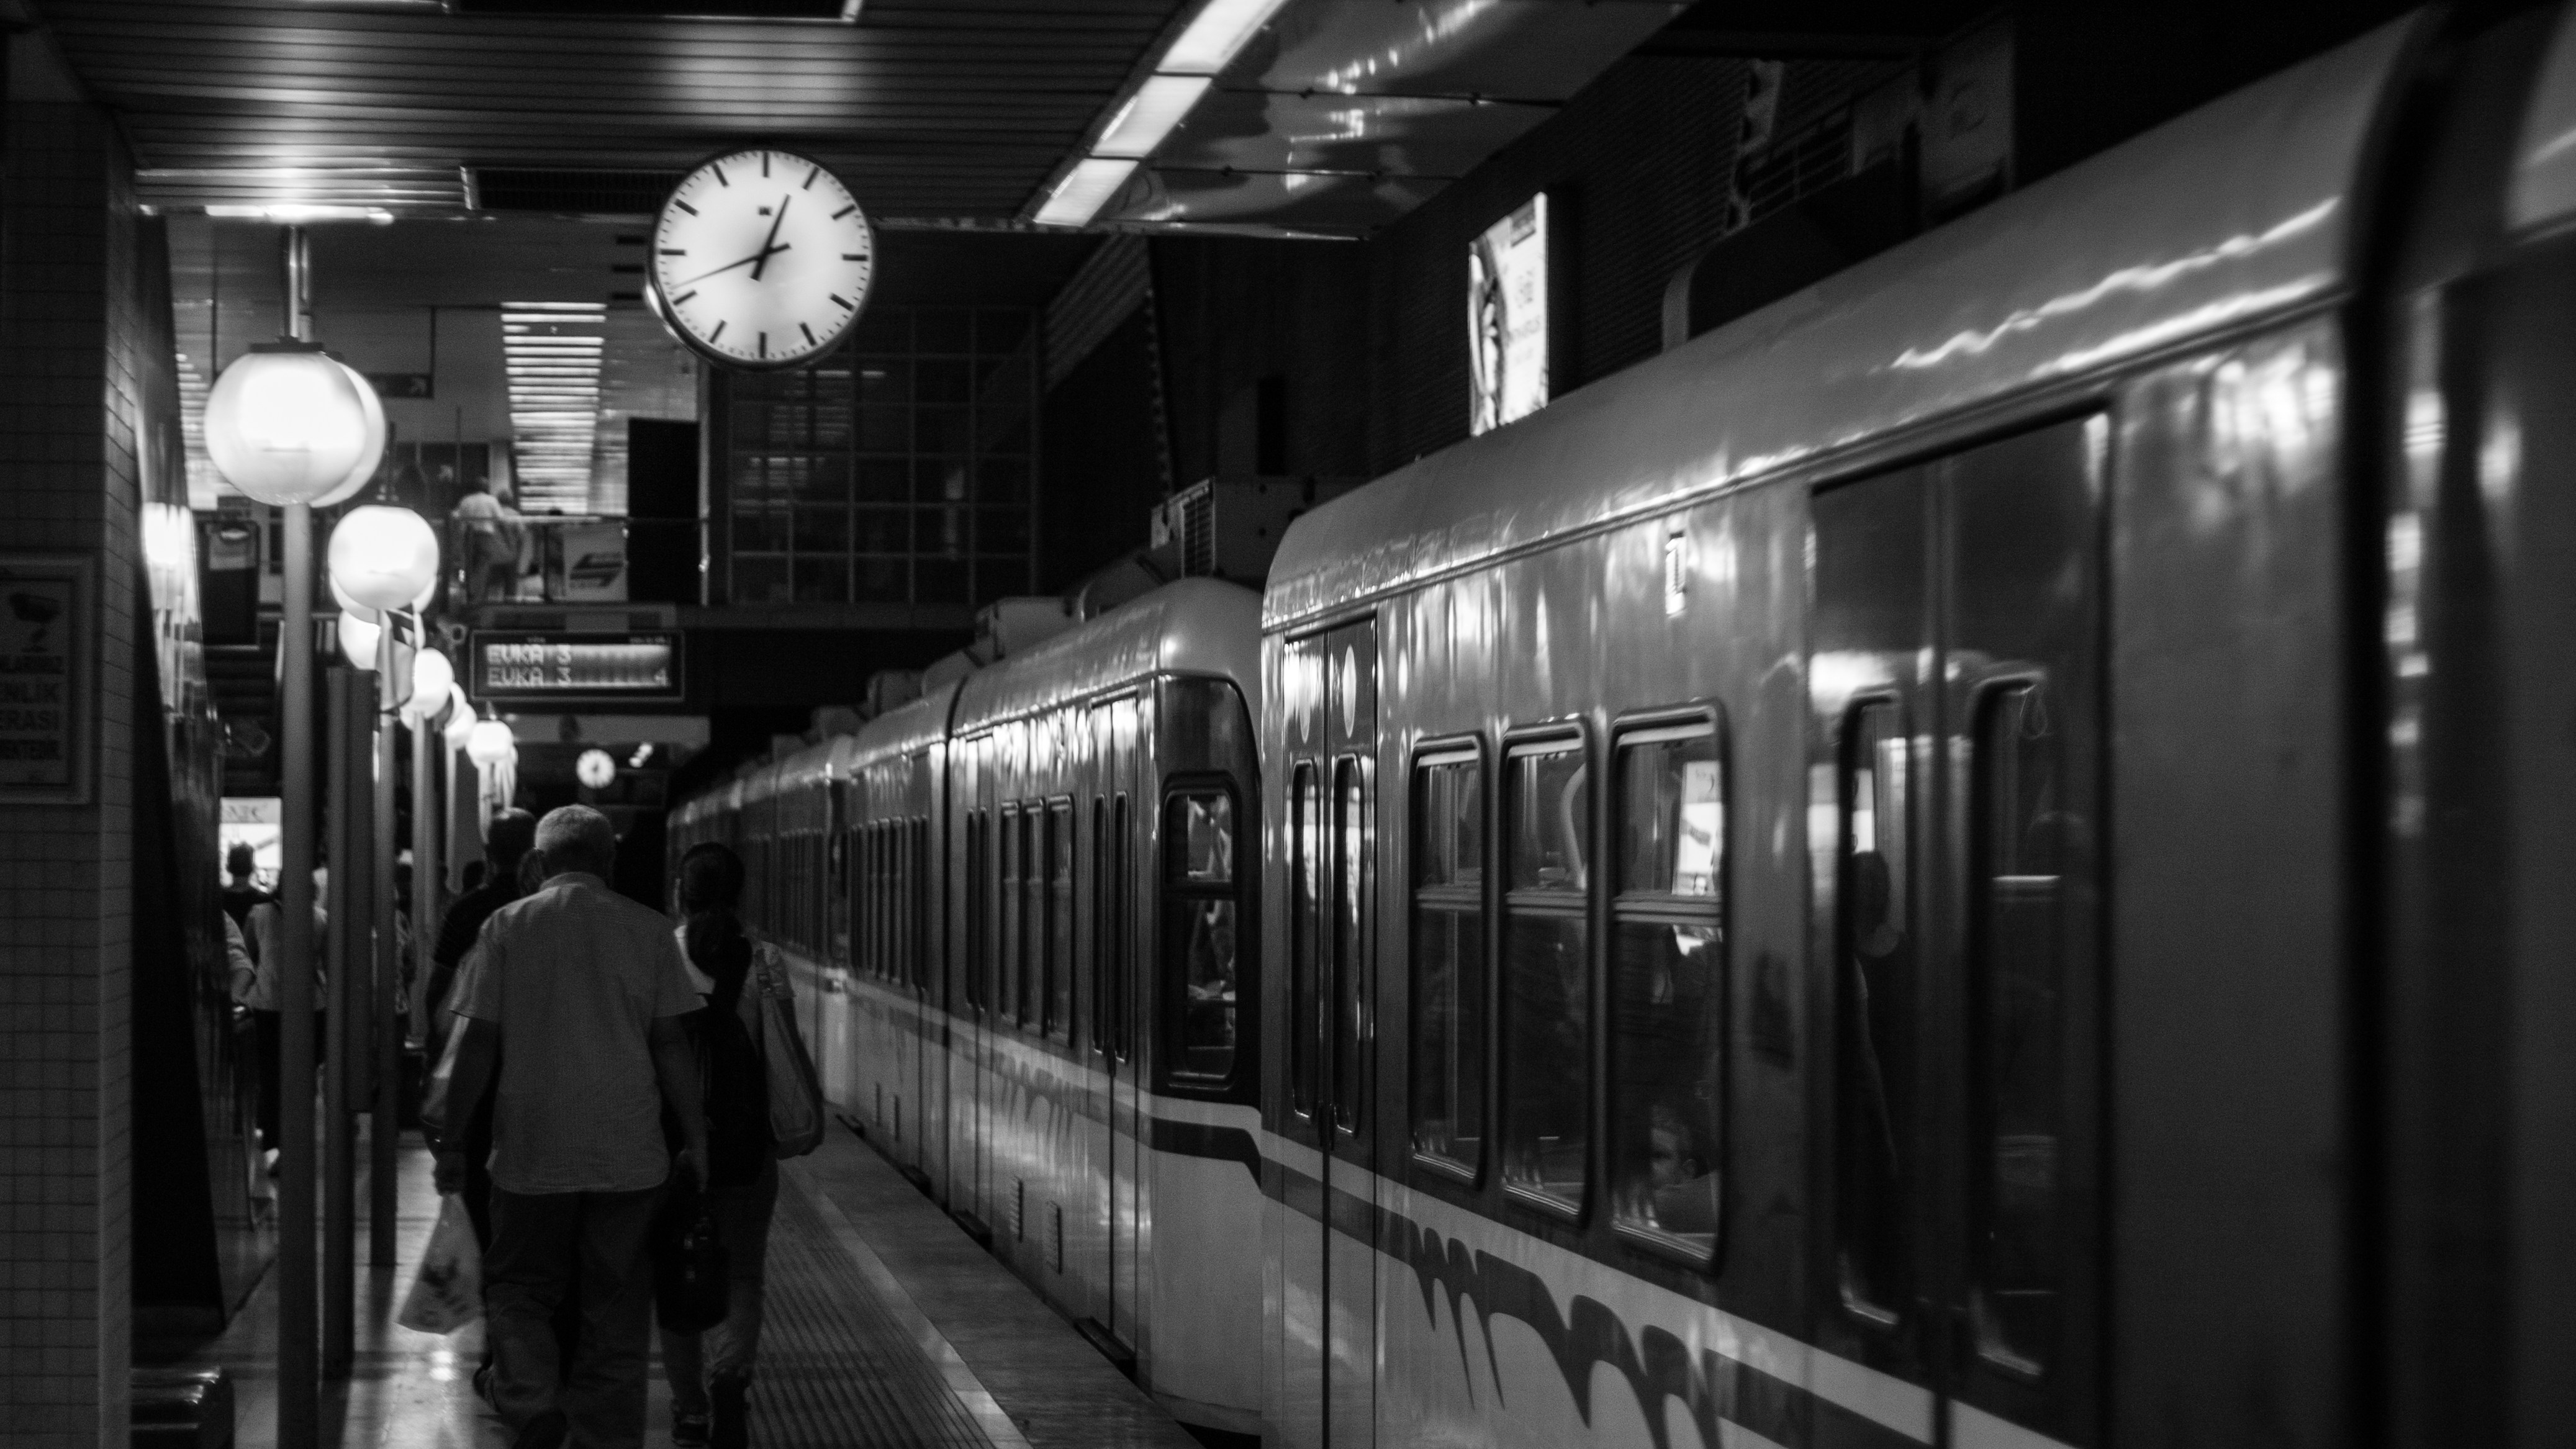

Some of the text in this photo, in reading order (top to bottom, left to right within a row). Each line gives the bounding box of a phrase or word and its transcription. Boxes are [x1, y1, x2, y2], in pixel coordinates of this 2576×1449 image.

[487, 644, 572, 665] EVKA 3
[487, 666, 545, 686] EVKA
[556, 666, 572, 686] 3
